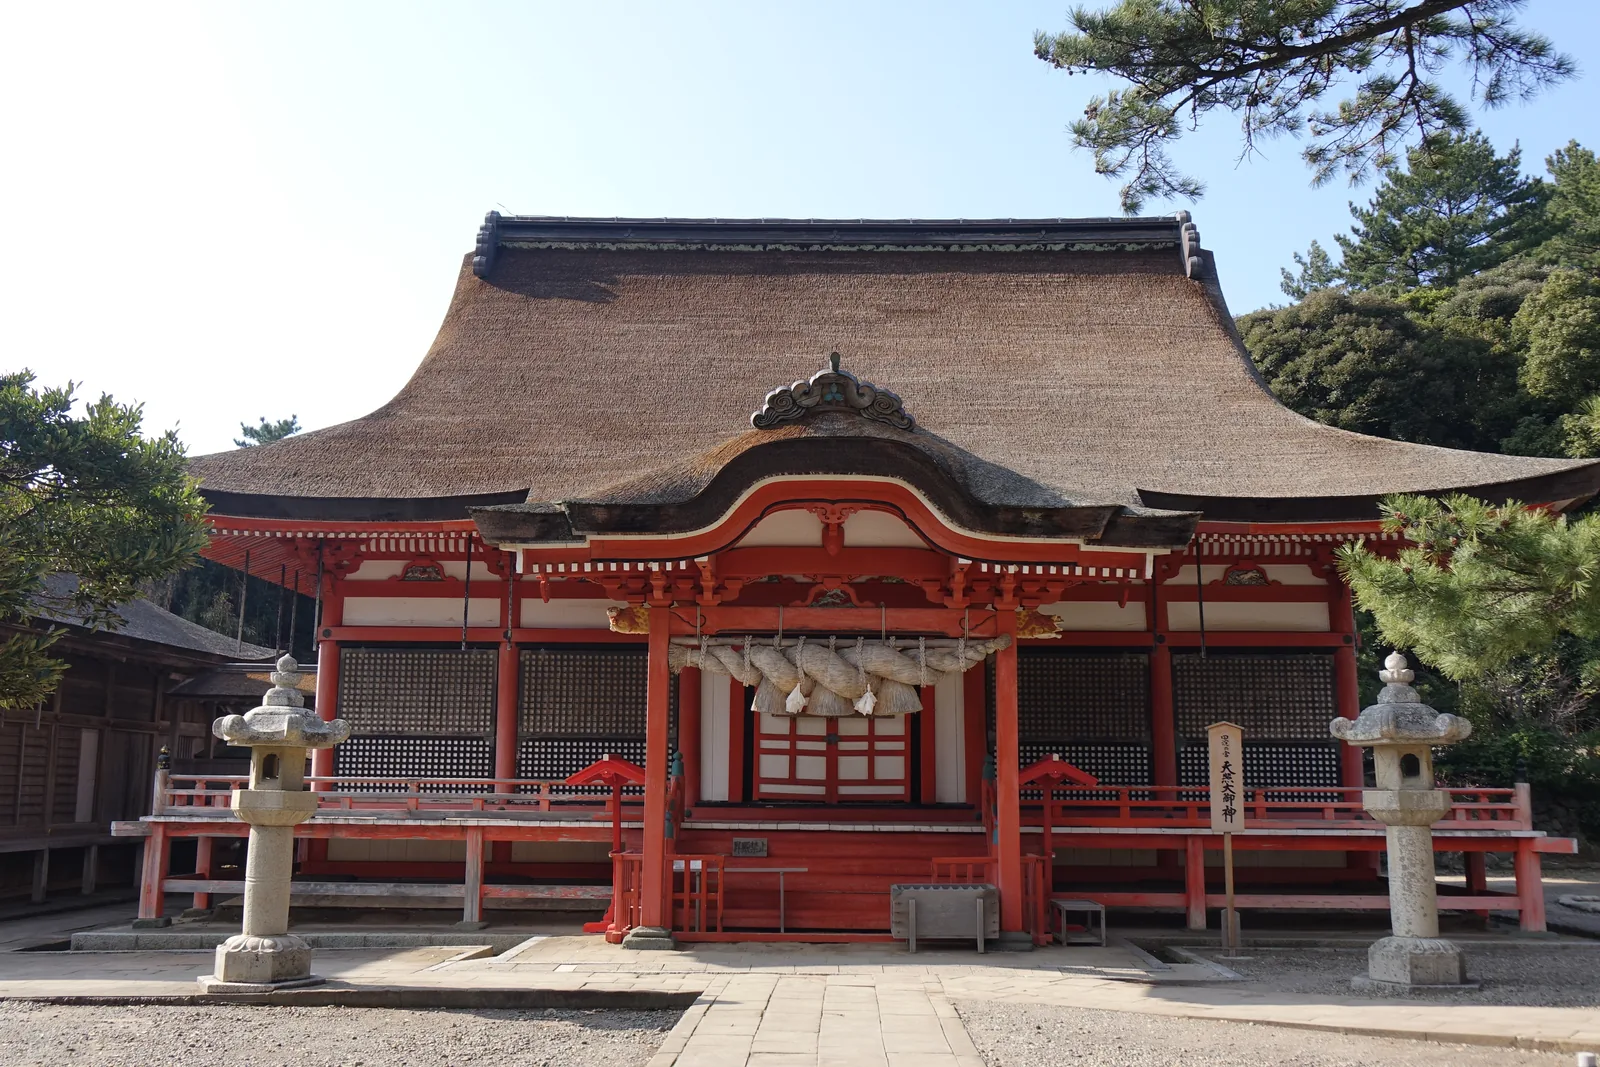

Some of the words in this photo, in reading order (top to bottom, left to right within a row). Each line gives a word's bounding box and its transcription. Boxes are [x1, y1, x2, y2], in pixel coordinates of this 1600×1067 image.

[1220, 761, 1236, 823] 天照大御神
